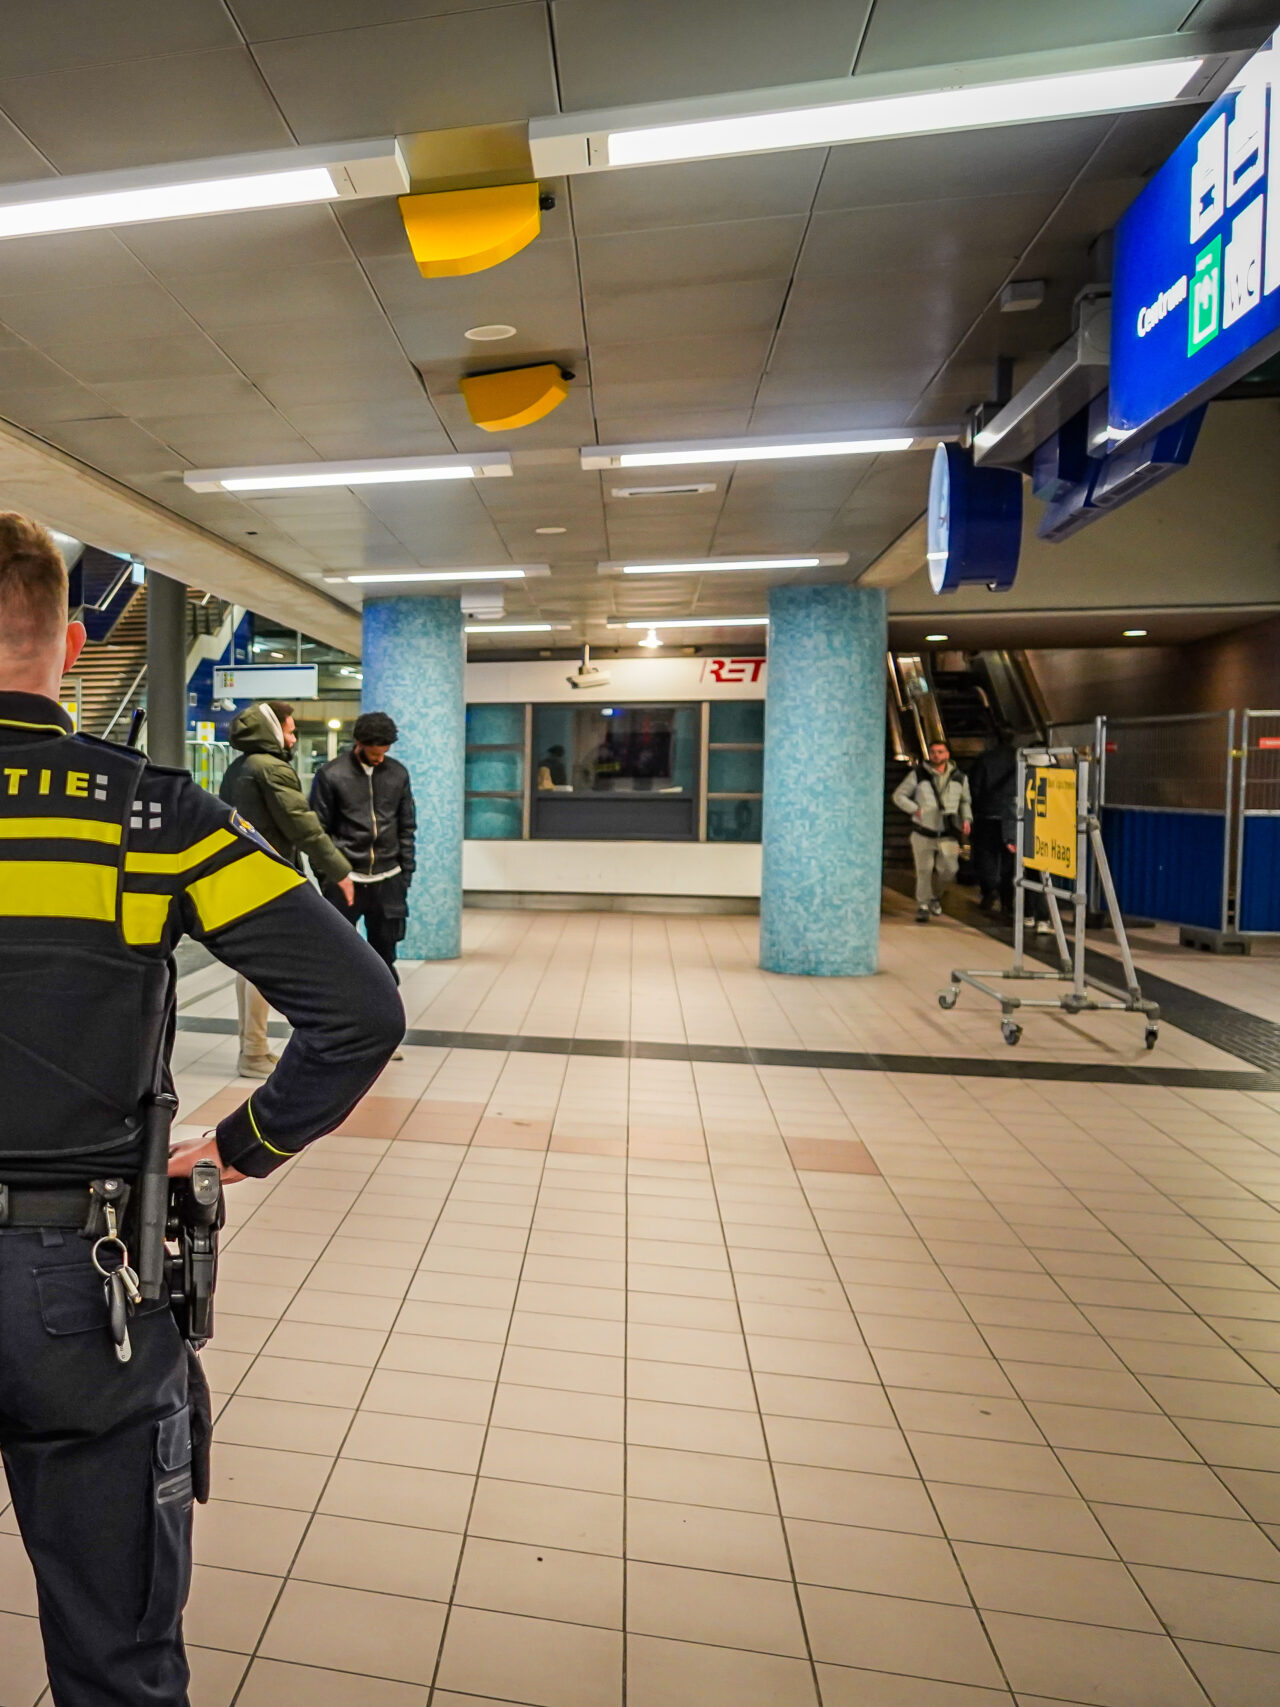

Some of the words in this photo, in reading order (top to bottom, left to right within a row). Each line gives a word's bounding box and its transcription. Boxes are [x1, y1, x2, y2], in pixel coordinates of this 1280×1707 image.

[1137, 275, 1188, 338] Centrum
[710, 658, 767, 682] RET
[1035, 835, 1049, 858] Den
[1051, 839, 1071, 868] Haag
